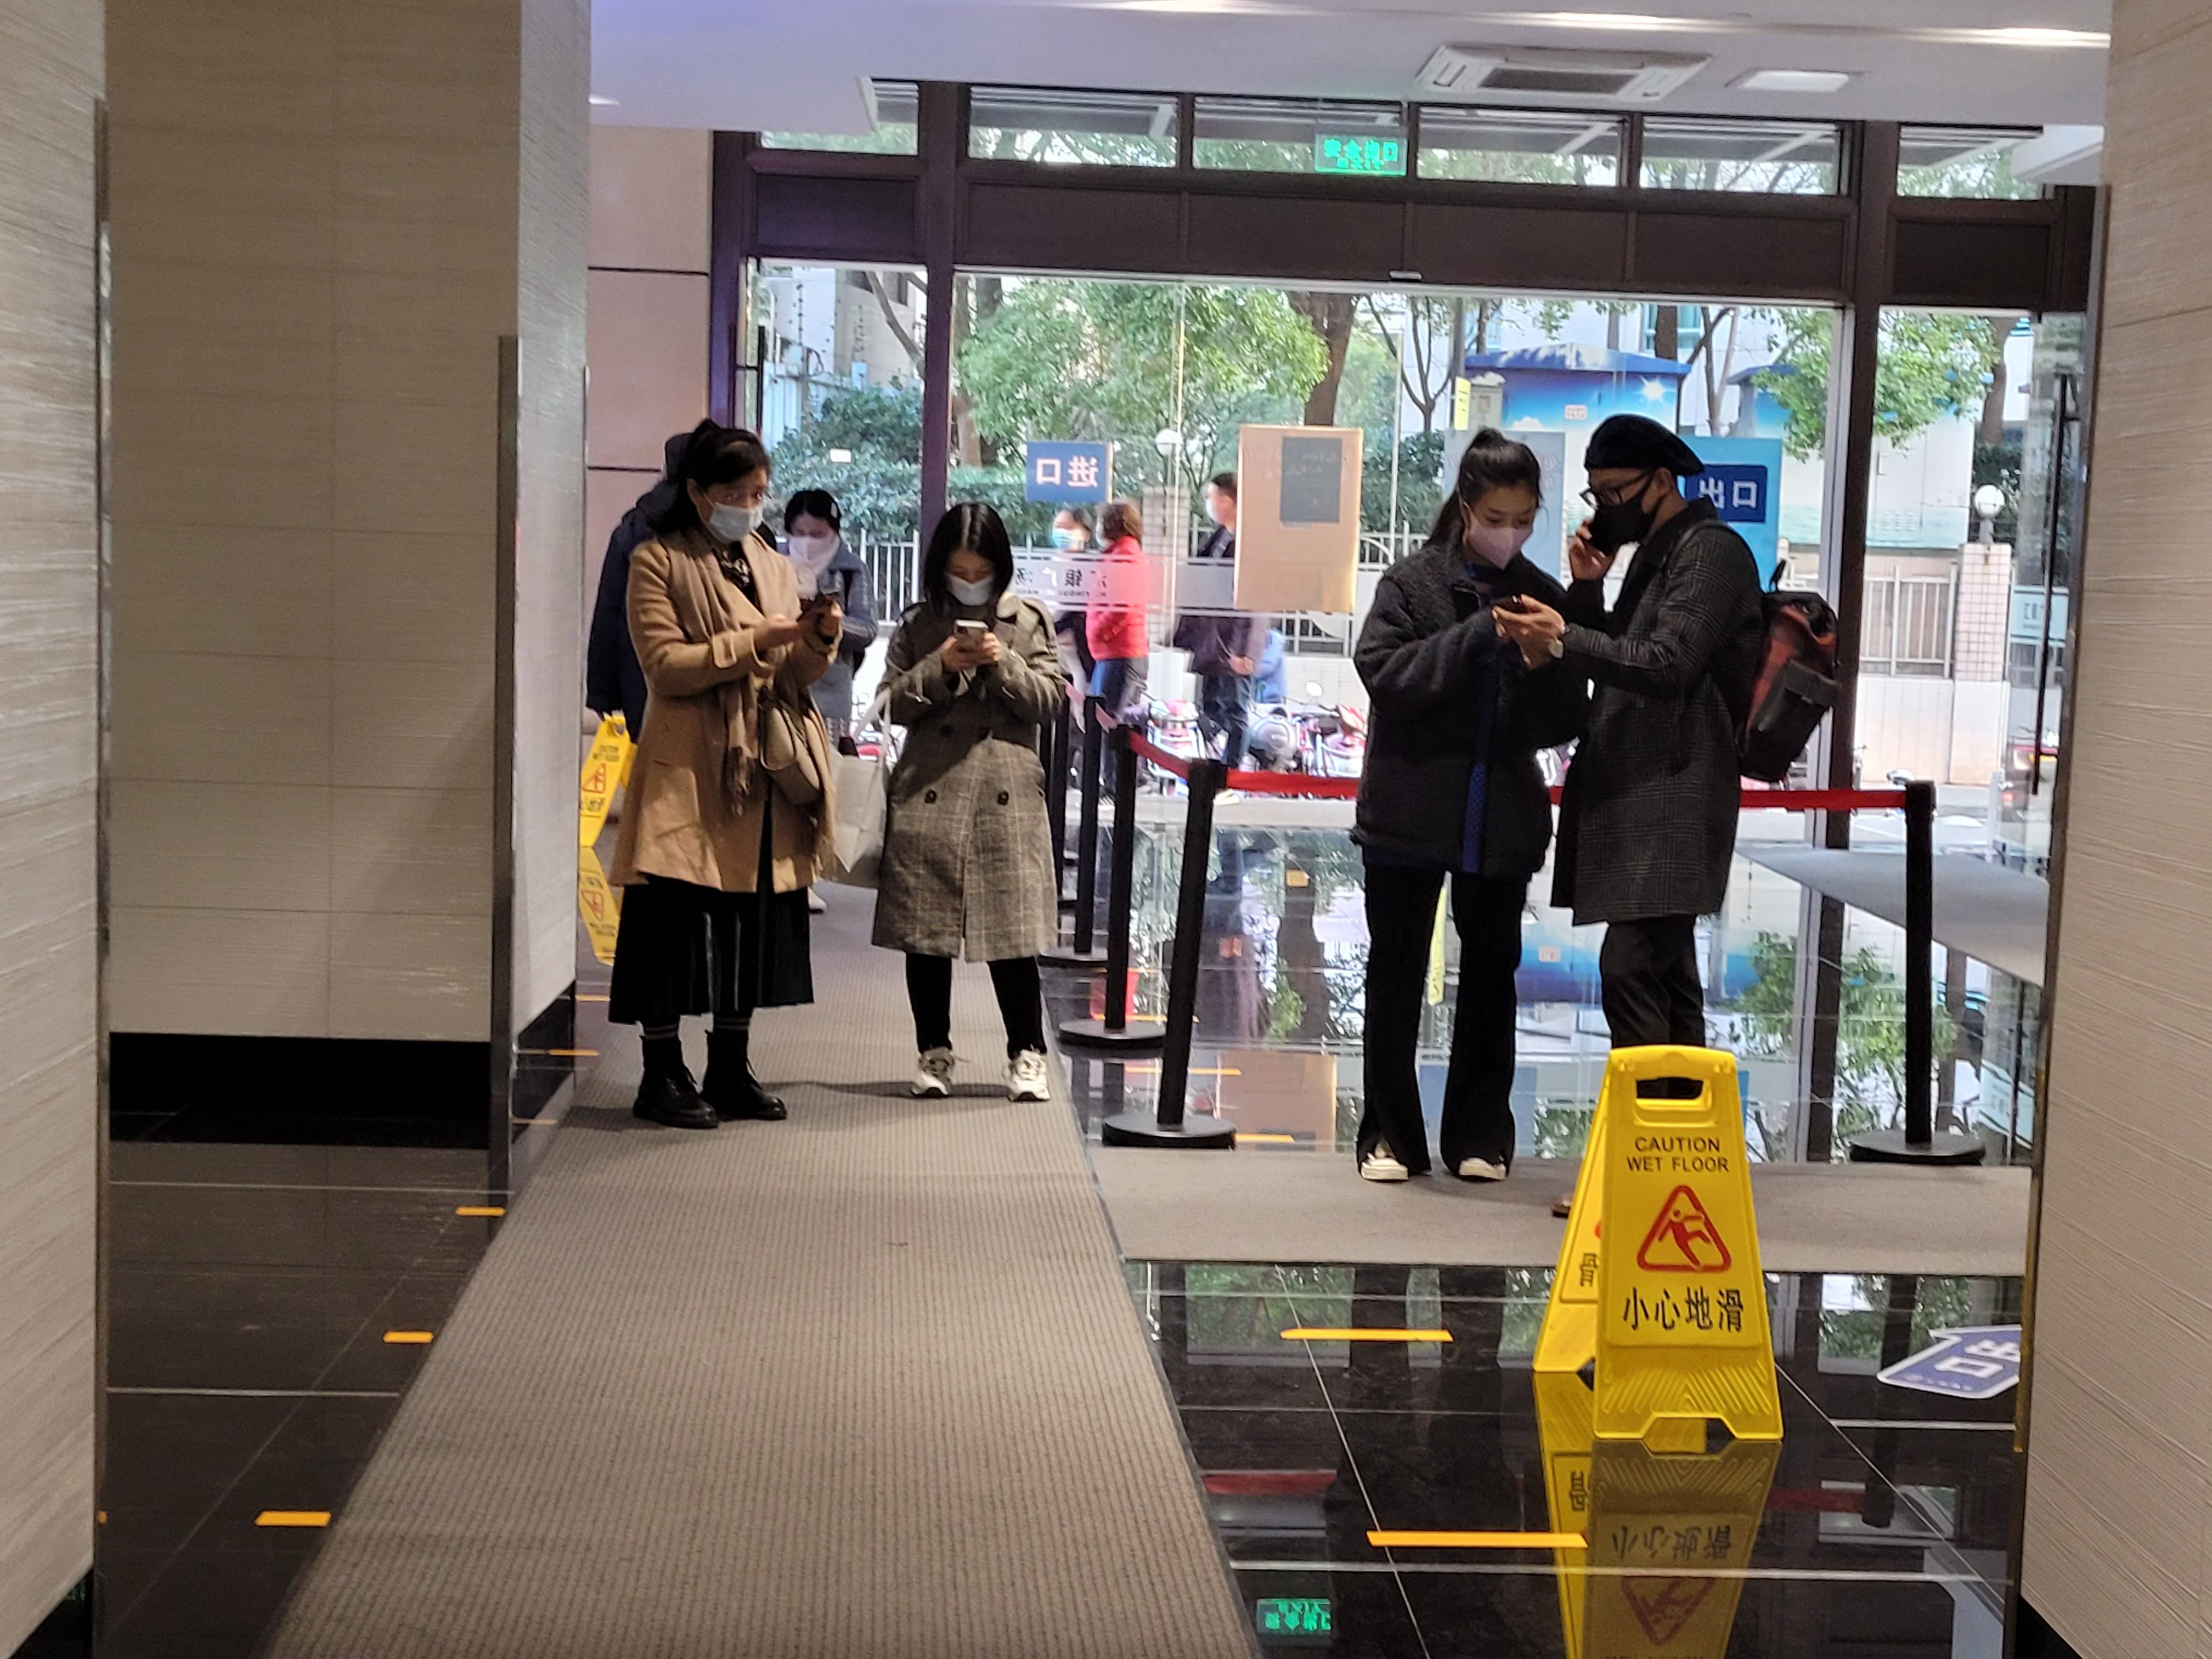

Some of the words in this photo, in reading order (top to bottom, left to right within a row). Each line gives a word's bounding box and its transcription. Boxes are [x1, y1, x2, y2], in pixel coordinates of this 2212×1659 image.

[1699, 477, 1758, 509] 出口
[1635, 1136, 1720, 1153] CAUTION
[1627, 1155, 1663, 1172] WET
[1672, 1156, 1729, 1172] FLOOR
[1623, 1287, 1743, 1332] 小心地滑
